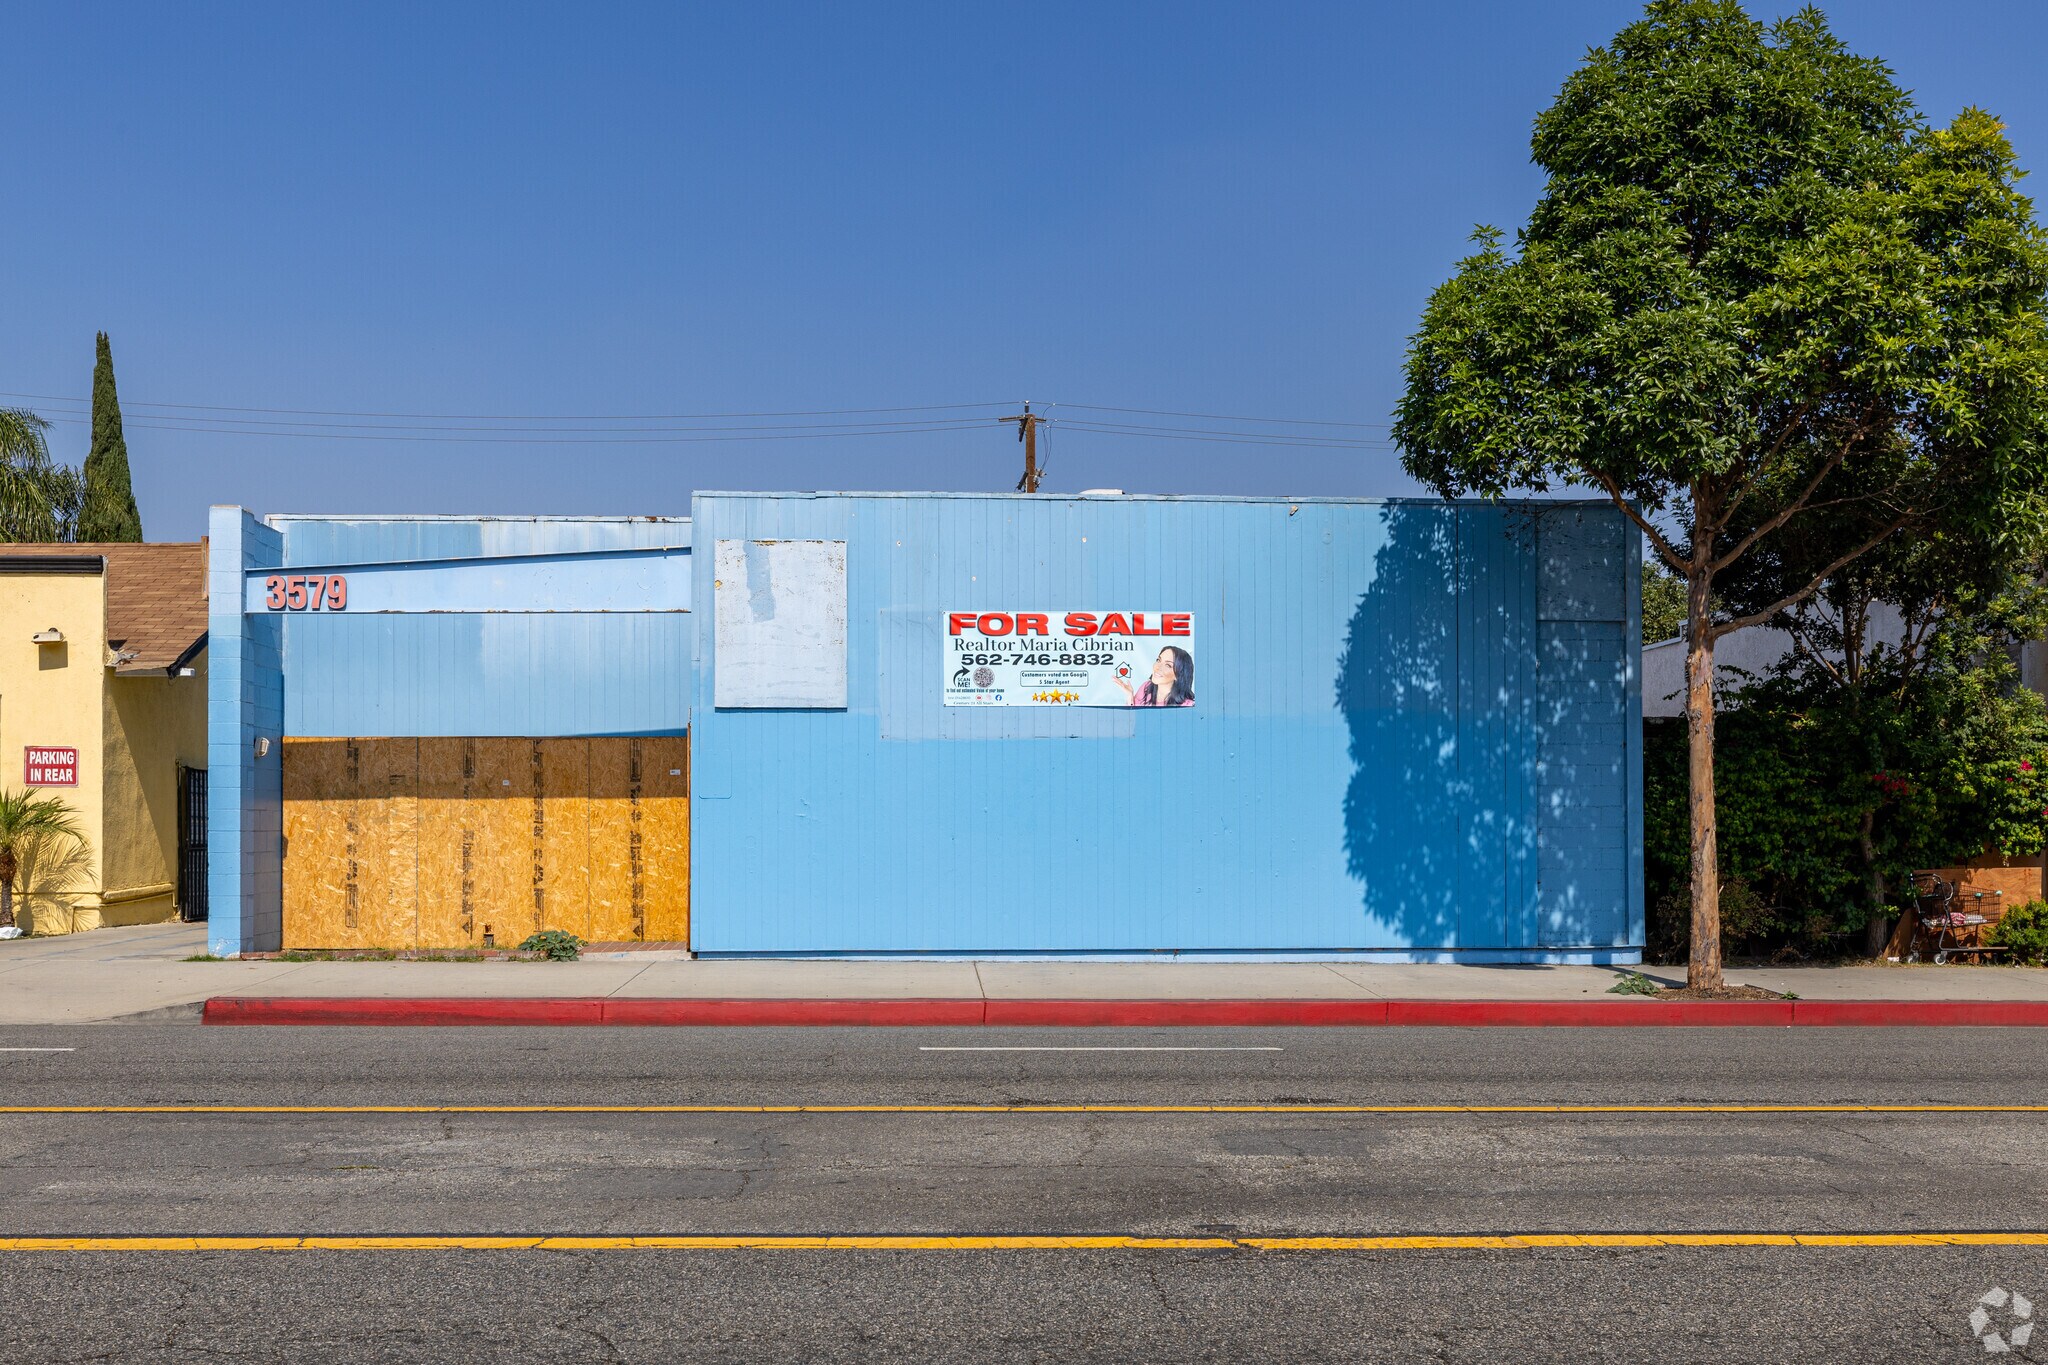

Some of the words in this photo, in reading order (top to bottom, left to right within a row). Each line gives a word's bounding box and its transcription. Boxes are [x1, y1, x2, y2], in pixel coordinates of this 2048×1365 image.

[265, 574, 348, 611] 3579
[949, 613, 1049, 636] FOR
[1064, 613, 1191, 636] SALE
[954, 638, 1015, 652] Realtor
[1020, 638, 1067, 652] Maria
[1072, 638, 1134, 652] Cibrian
[961, 653, 1114, 666] 562-746-8832
[29, 750, 75, 765] PARKING
[30, 768, 41, 782] IN
[44, 768, 73, 782] REAR
